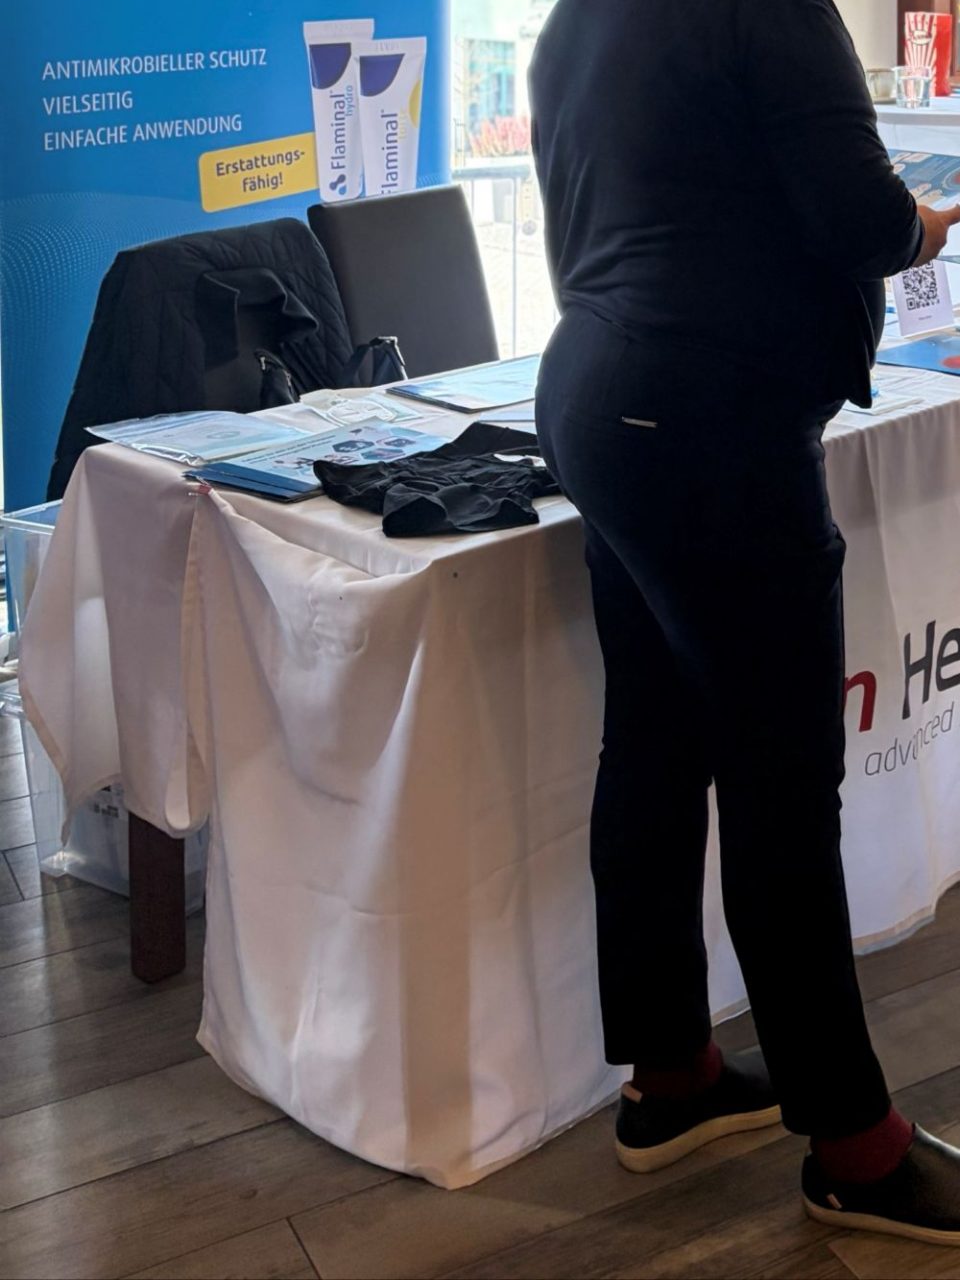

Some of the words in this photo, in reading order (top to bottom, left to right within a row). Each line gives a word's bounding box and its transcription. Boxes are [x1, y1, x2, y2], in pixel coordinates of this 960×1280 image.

[42, 53, 205, 81] ANTIMIKROBIELLER
[209, 48, 267, 68] SCHUTZ
[42, 90, 134, 116] VIELSEITIG
[44, 125, 128, 152] EINFACHE
[133, 114, 243, 142] ANWENDUNG
[329, 92, 347, 170] Flaminal
[215, 148, 306, 177] Erstattungs-
[242, 171, 284, 193] fähig!
